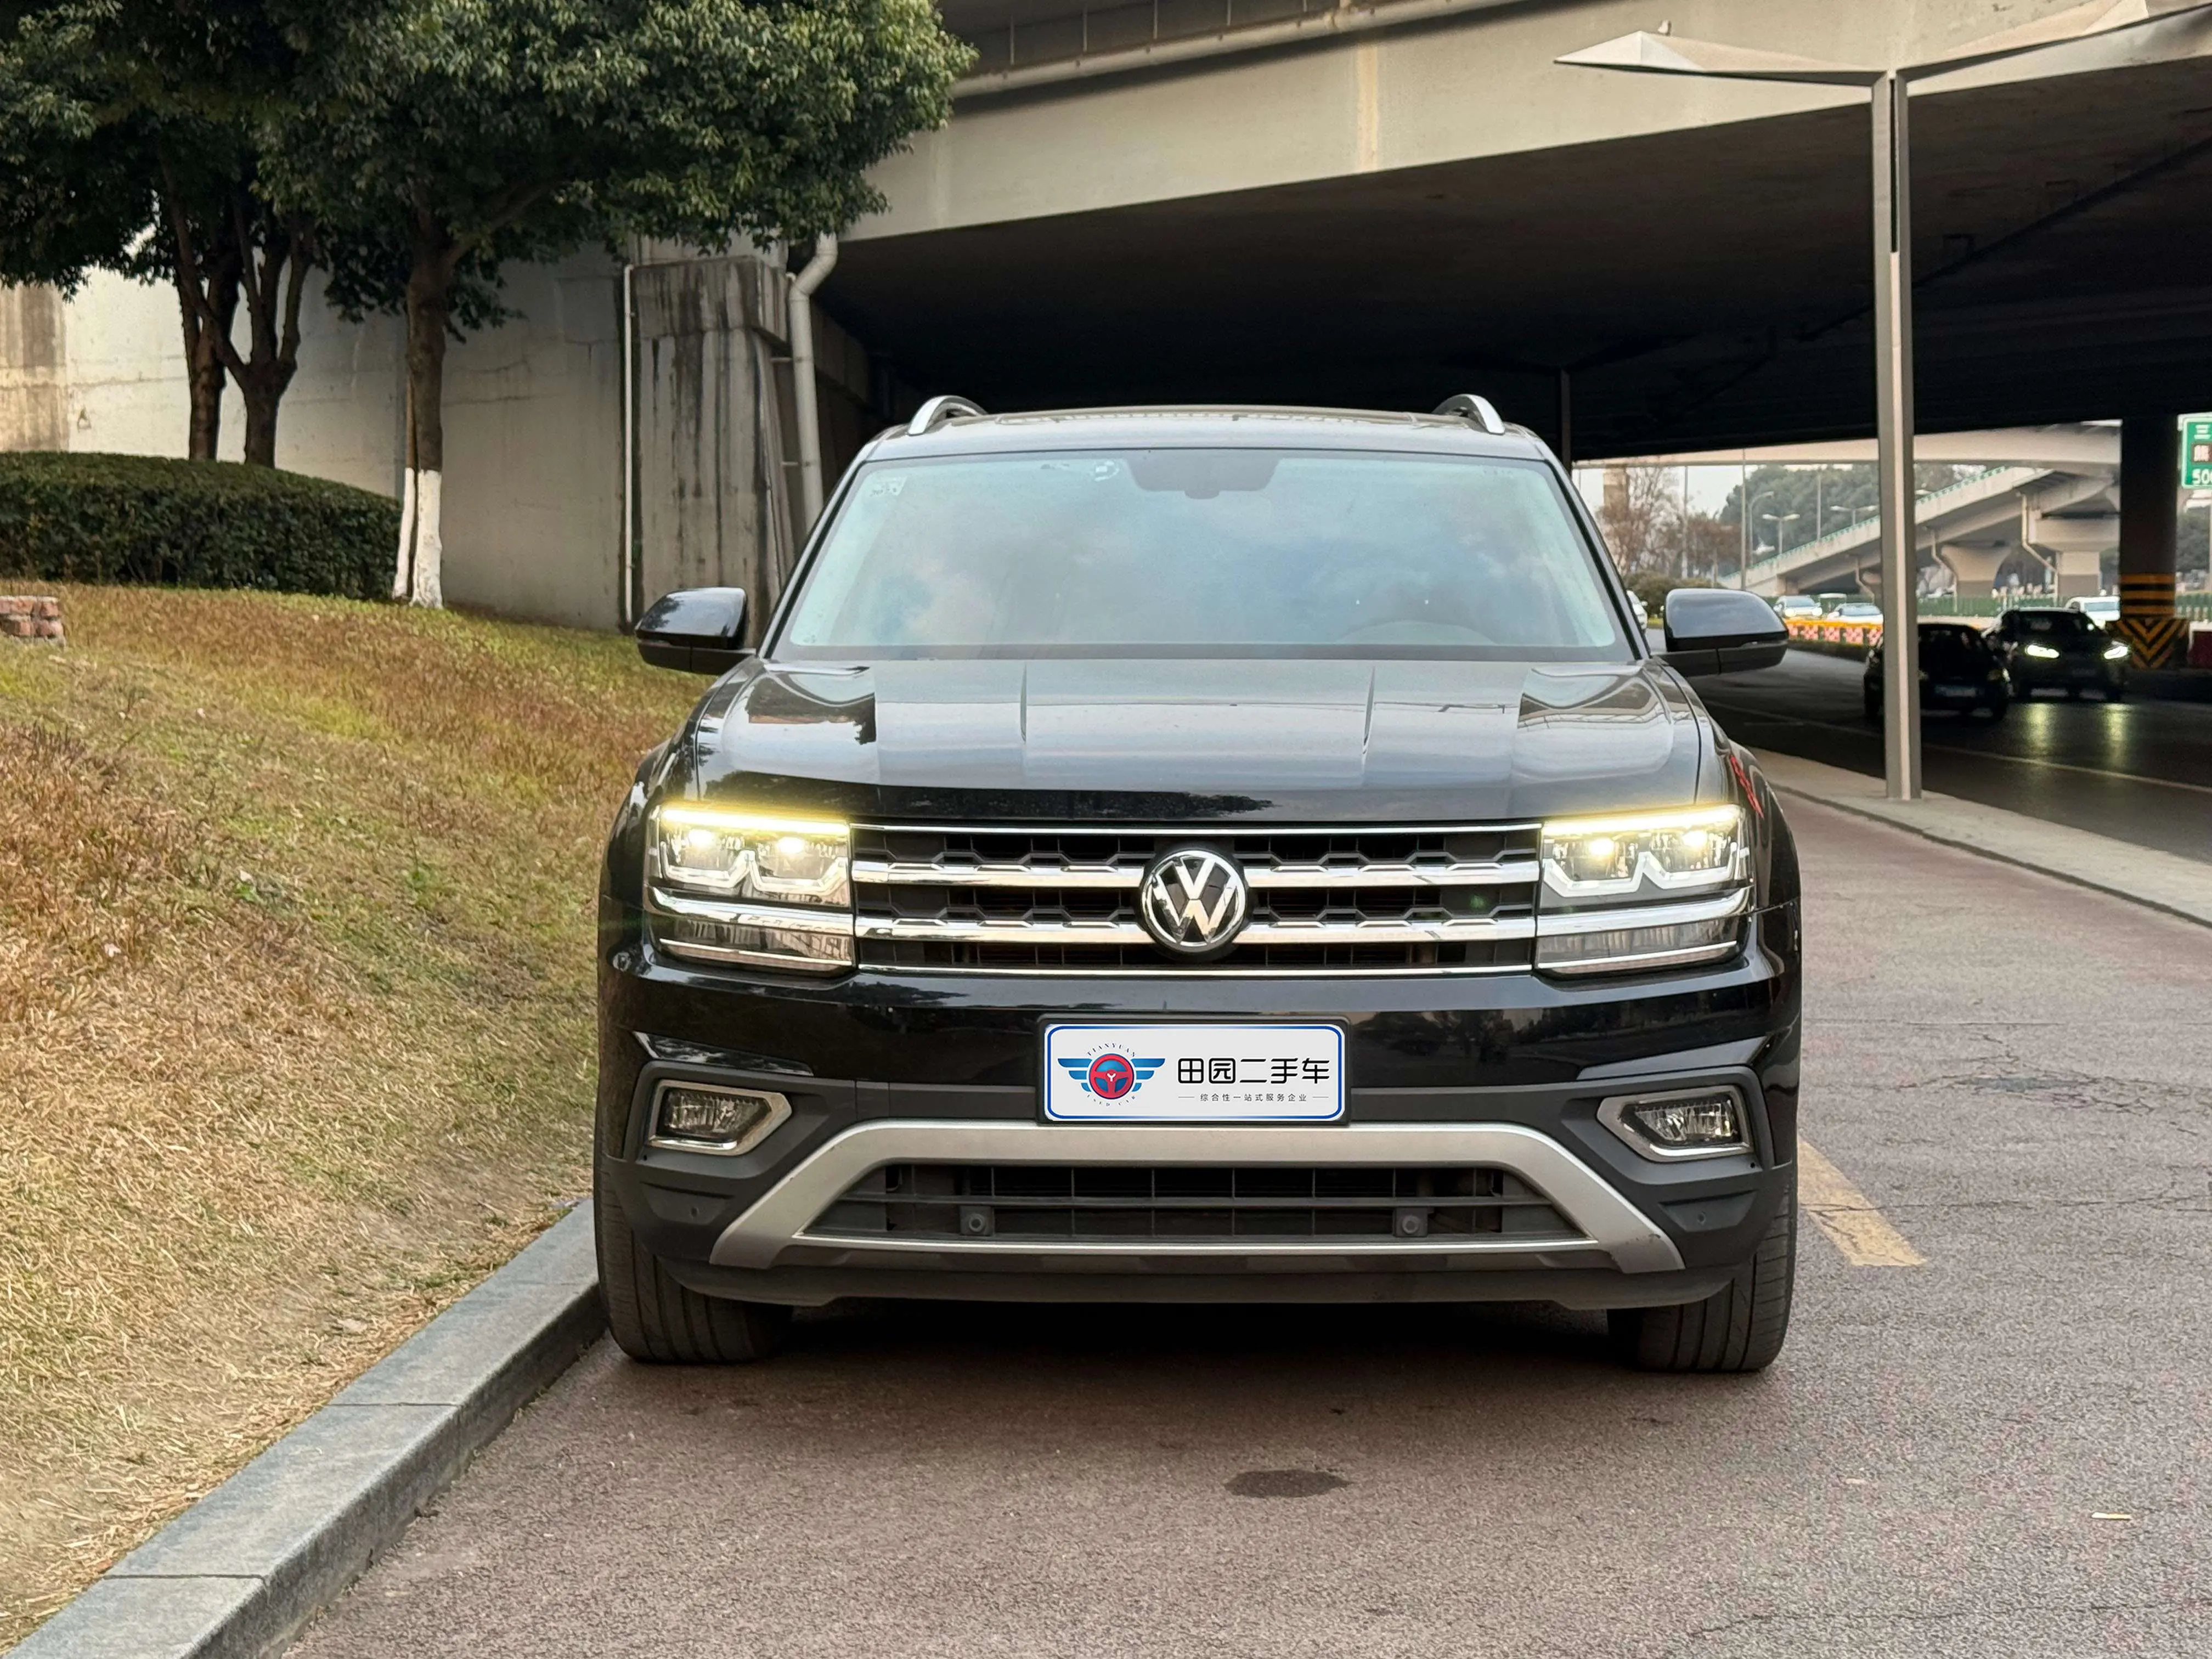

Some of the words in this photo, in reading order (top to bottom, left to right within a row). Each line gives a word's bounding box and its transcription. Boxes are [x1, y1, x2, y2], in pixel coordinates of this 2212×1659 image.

[2192, 469, 2212, 484] 50
[1178, 1058, 1330, 1084] 田园二手车
[1200, 1093, 1308, 1102] 综合性一站式服务企业
